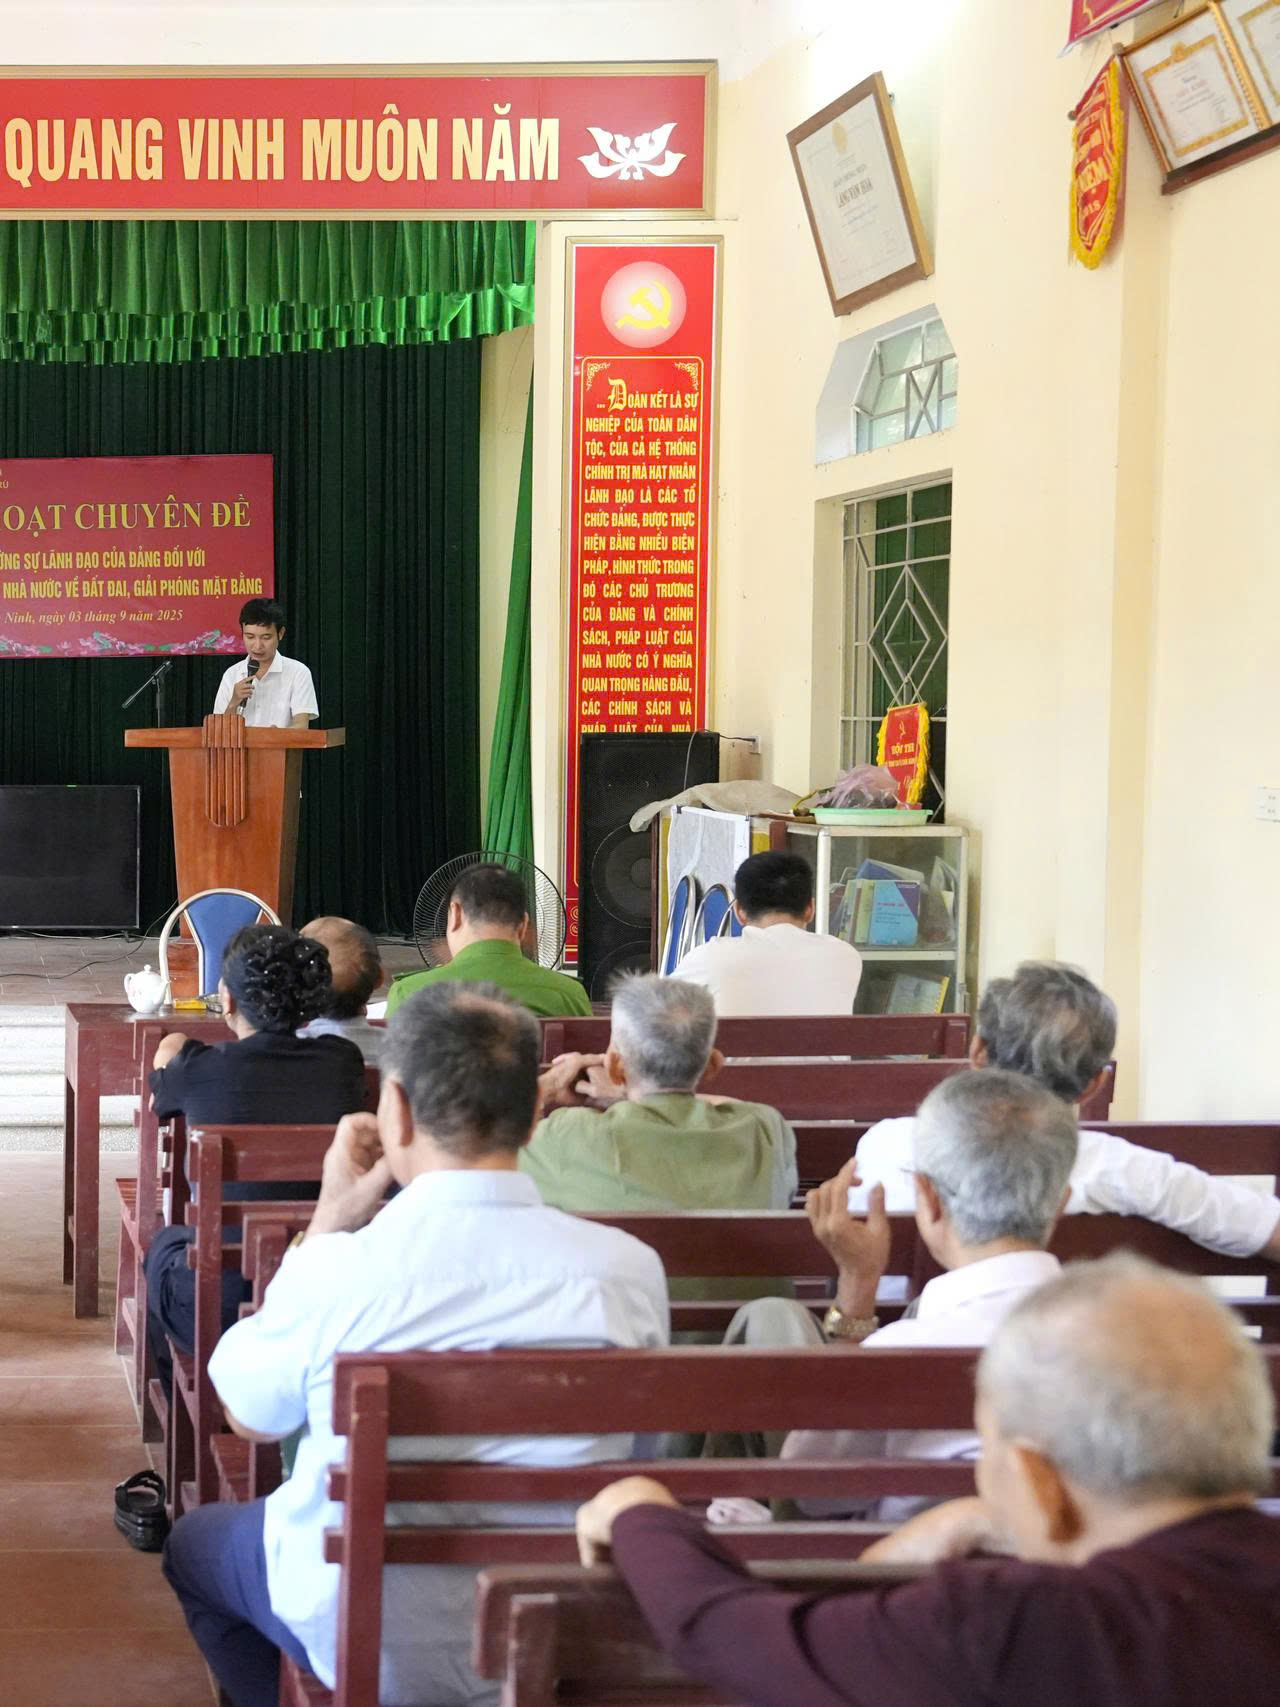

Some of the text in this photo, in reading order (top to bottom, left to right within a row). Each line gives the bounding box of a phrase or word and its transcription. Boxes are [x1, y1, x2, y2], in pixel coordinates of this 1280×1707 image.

[4, 117, 163, 188] QUANG
[176, 118, 284, 181] VINH
[302, 103, 437, 182] MUÔN
[452, 103, 560, 182] NĂM
[650, 389, 668, 408] KẾT
[670, 390, 682, 408] LÀ
[685, 392, 699, 411] SỰ
[586, 412, 697, 435] NGHIỆP CỦA TOÀN DÂN
[586, 436, 697, 459] TỘC, CỦA CẢ HỆ THỐNG
[585, 462, 696, 483] CHÍNH TRỊ MÀ HẠT NHÂN
[585, 483, 696, 507] LÃNH ĐẠO LÀ CÁC TỔ
[74, 494, 201, 530] CHUYÊN
[211, 493, 251, 528] ĐỀ
[584, 504, 695, 530] CHỨC ĐẢNG, ĐƯỢC THỰC
[584, 530, 694, 553] HIỆN BẰNG NHIỀU BIỆN
[24, 552, 40, 573] SỰ
[43, 550, 72, 569] LÃNH
[76, 551, 99, 572] ĐẠO
[103, 546, 126, 568] CỦA
[129, 545, 160, 568] ĐẢNG
[164, 545, 183, 567] ĐỐI
[187, 547, 205, 567] VỚI
[583, 556, 694, 575] PHÁP, HÌNH THỨC TRONG
[3, 579, 27, 599] NHÀ
[30, 578, 61, 598] NƯỚC
[65, 576, 79, 598] VỀ
[83, 575, 104, 597] ĐẤT
[107, 579, 130, 598] ĐAI,
[134, 574, 157, 596] GIẢI
[160, 575, 199, 596] PHÓNG
[203, 575, 227, 599] MẶT
[231, 572, 262, 595] BẰNG
[583, 577, 693, 598] ĐÓ CÁC CHỦ TRƯƠNG
[4, 612, 35, 625] Ninh,
[39, 613, 65, 625] ngày
[68, 611, 82, 622] 03
[85, 610, 116, 624] tháng
[120, 610, 127, 621] 9
[129, 611, 153, 621] năm
[157, 609, 184, 621] 2025
[583, 601, 693, 621] CỦA ĐẢNG VÀ CHÍNH
[583, 624, 693, 648] SÁCH, PHÁP LUẬT CỦA
[582, 650, 692, 669] NHÀ NƯỚC CÓ Ý NGHĨA
[582, 673, 692, 695] QUAN TRỌNG HÀNG ĐẦU,
[581, 698, 692, 716] CÁC CHÍNH SÁCH VÀ
